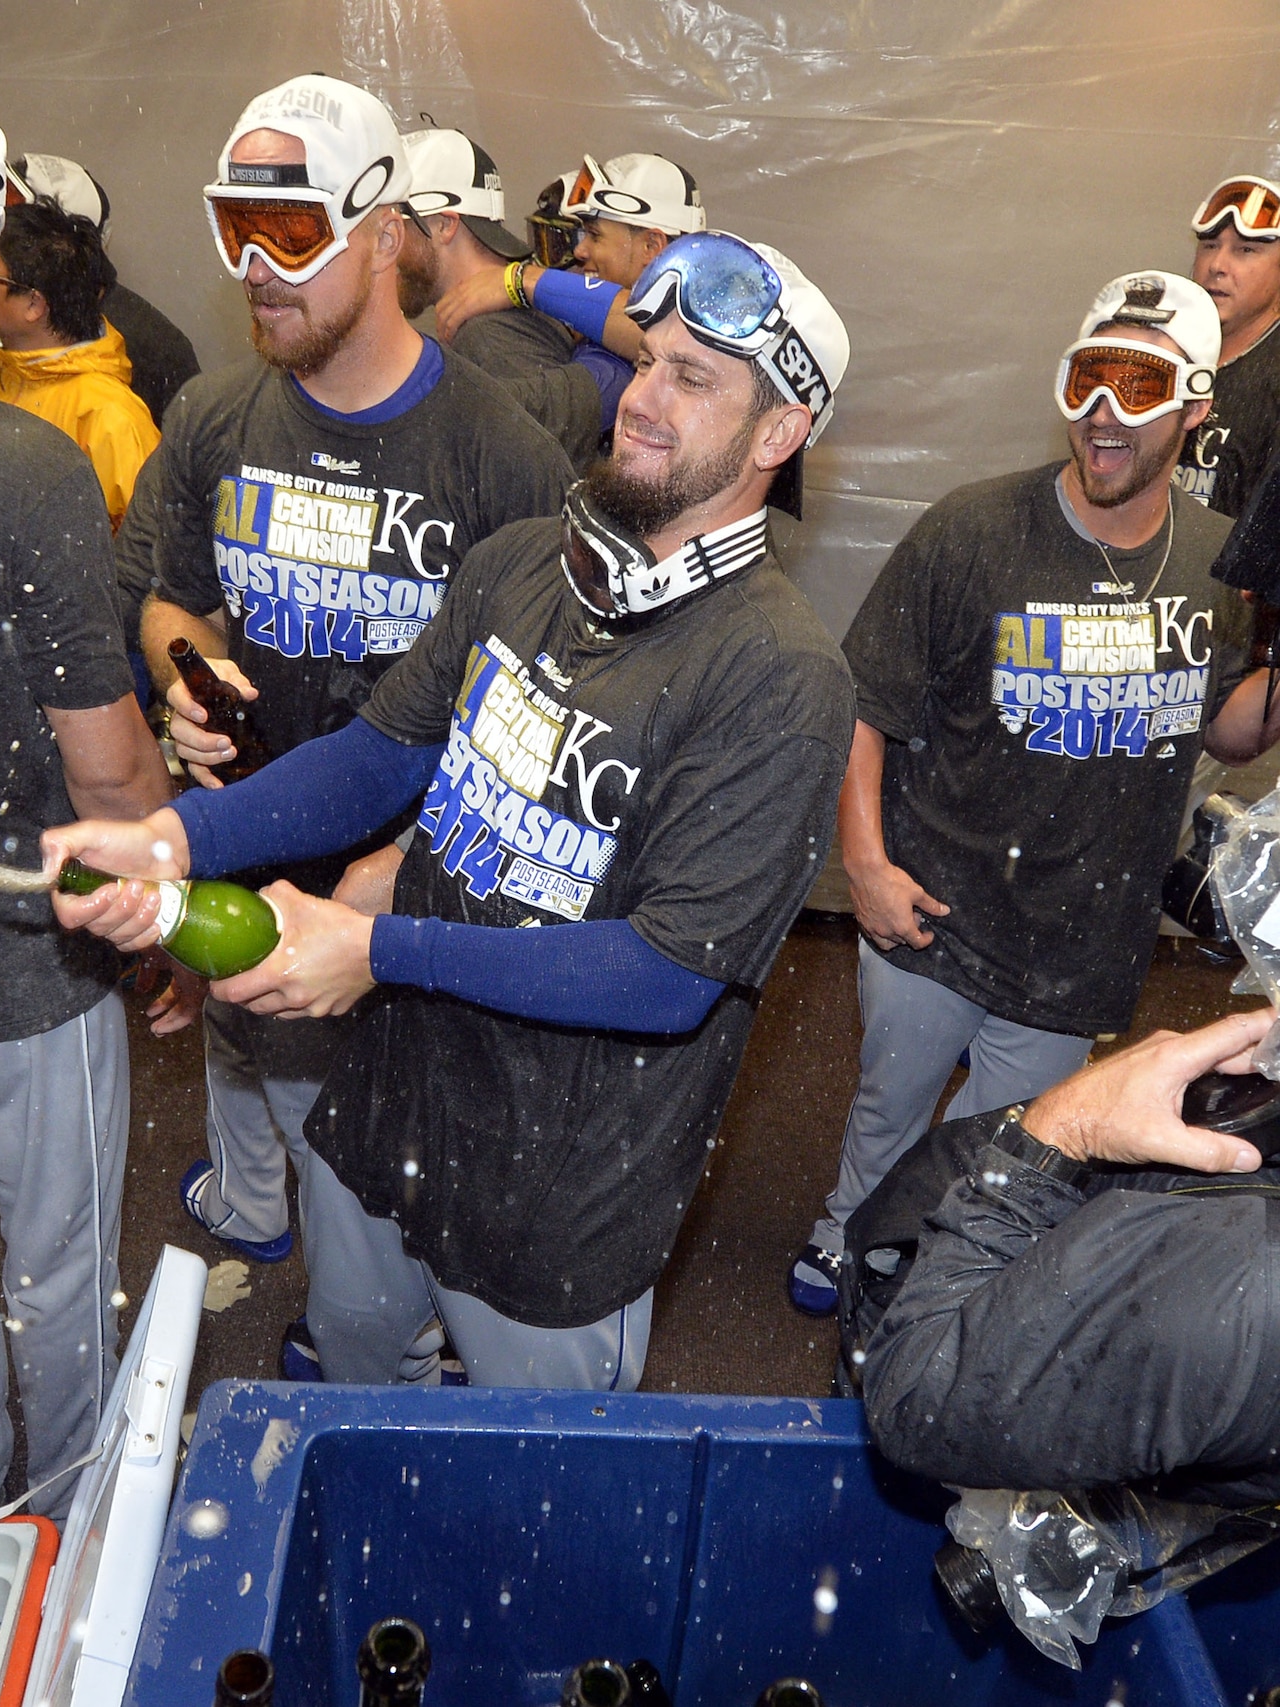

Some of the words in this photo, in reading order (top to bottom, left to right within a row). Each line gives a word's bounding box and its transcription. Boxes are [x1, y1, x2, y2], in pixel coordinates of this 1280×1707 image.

[241, 464, 293, 488] KANSAS
[294, 475, 325, 494] CITY
[326, 482, 377, 502] ROYALS
[215, 478, 260, 546] AL
[273, 491, 372, 537] CENTRAL
[372, 487, 455, 580] KC
[267, 521, 371, 567] DIVISION
[213, 540, 447, 622] POSTSEASON
[243, 588, 368, 662] 2014
[369, 622, 426, 639] POSTSEASO
[1026, 602, 1077, 616] KANSAS
[1077, 603, 1108, 616] CITY
[1063, 619, 1155, 647] CENTRAL
[1153, 595, 1213, 667] KC
[993, 615, 1054, 670] AL
[1062, 645, 1155, 673] DIVISION
[991, 668, 1210, 712] POSTSEASON
[1025, 705, 1151, 760] 2014
[549, 708, 642, 832] KC
[440, 720, 618, 884] STSEASON
[510, 859, 584, 902] POSTSEASON
